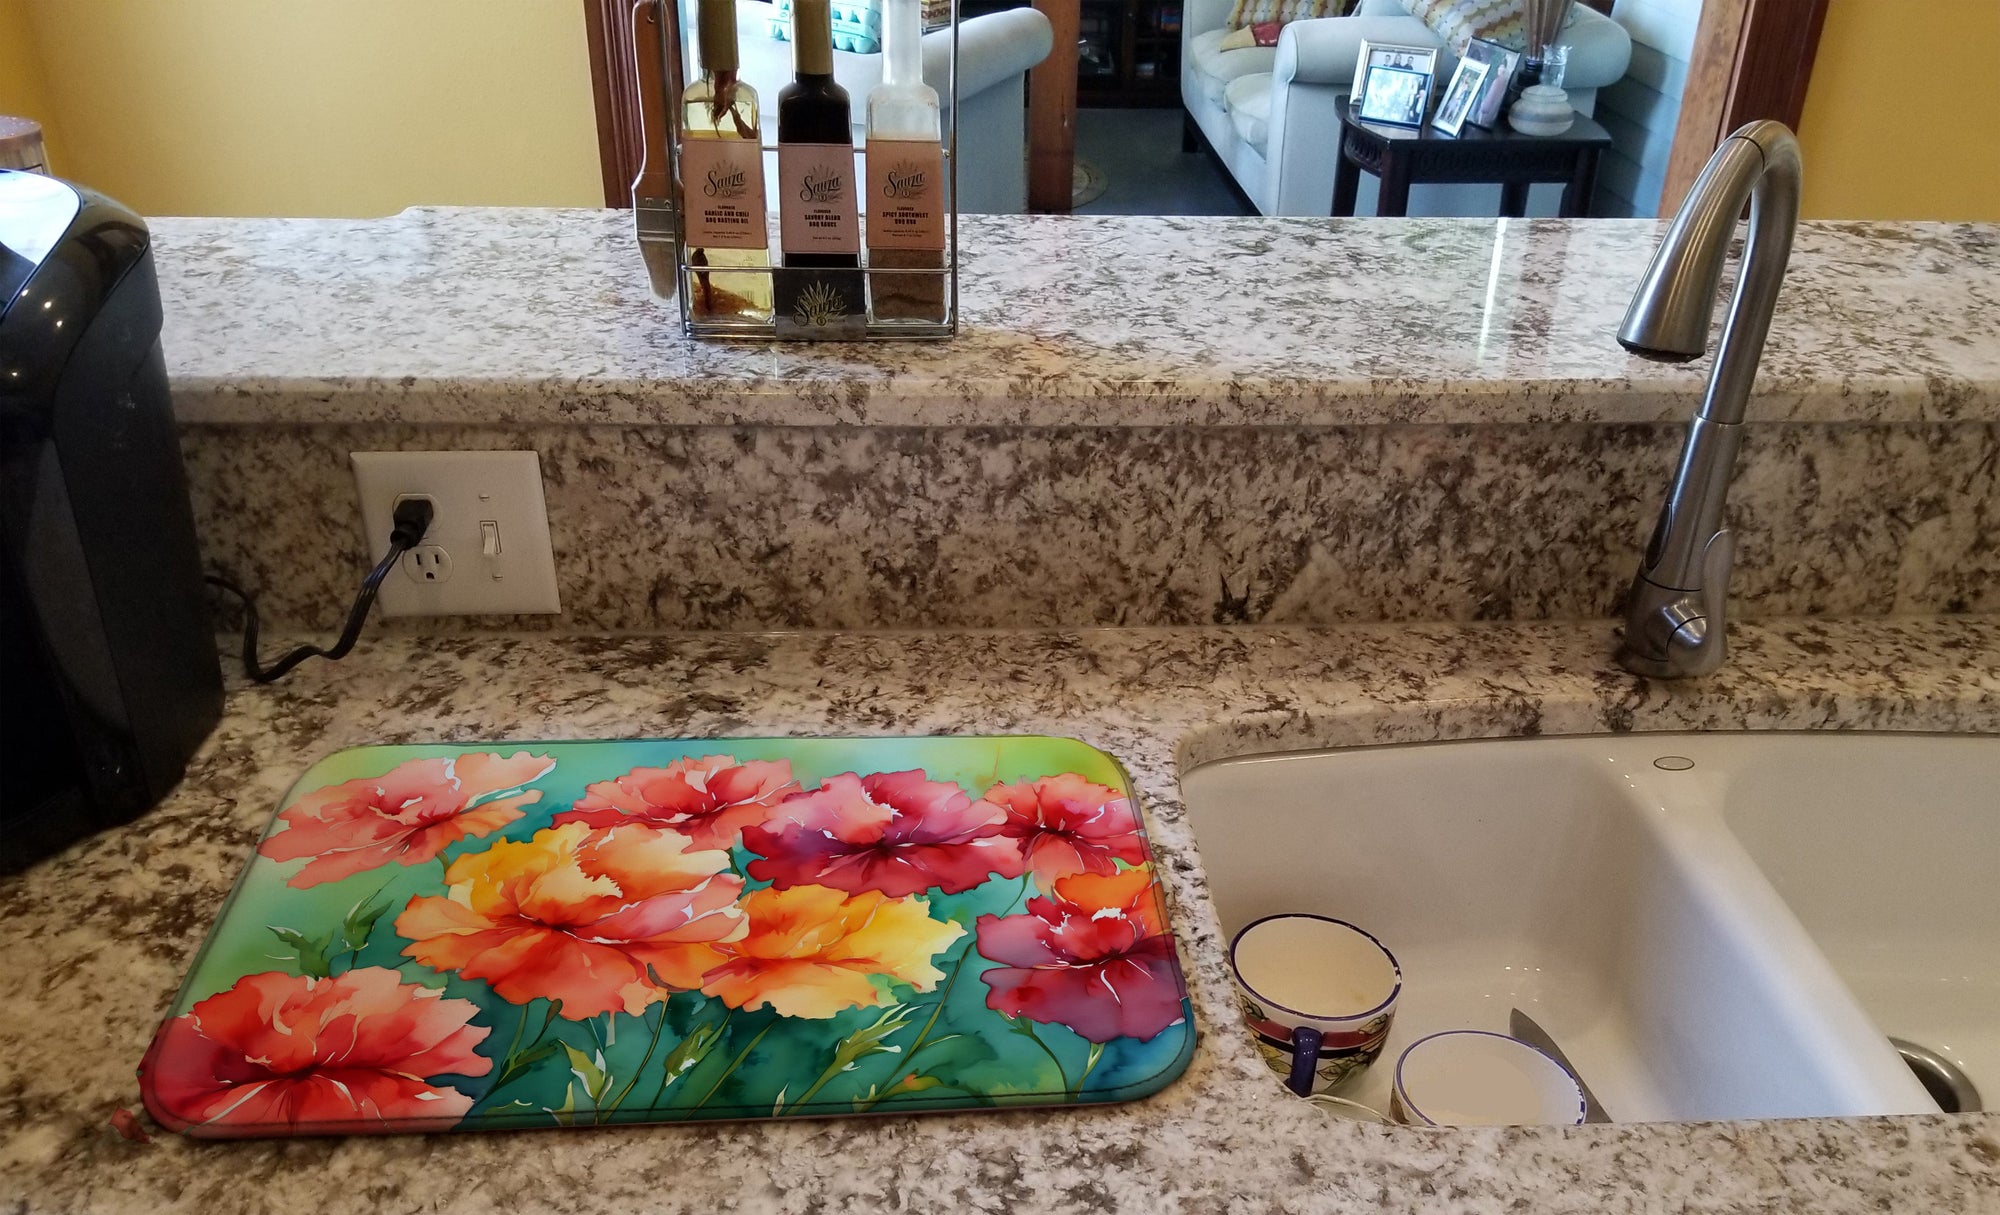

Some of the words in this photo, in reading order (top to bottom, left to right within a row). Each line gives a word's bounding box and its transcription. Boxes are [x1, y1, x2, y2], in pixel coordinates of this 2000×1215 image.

[704, 170, 745, 197] Sauza
[800, 175, 841, 202] Sauza
[884, 171, 925, 198] Sauza
[898, 211, 929, 219] SOUTHWEST
